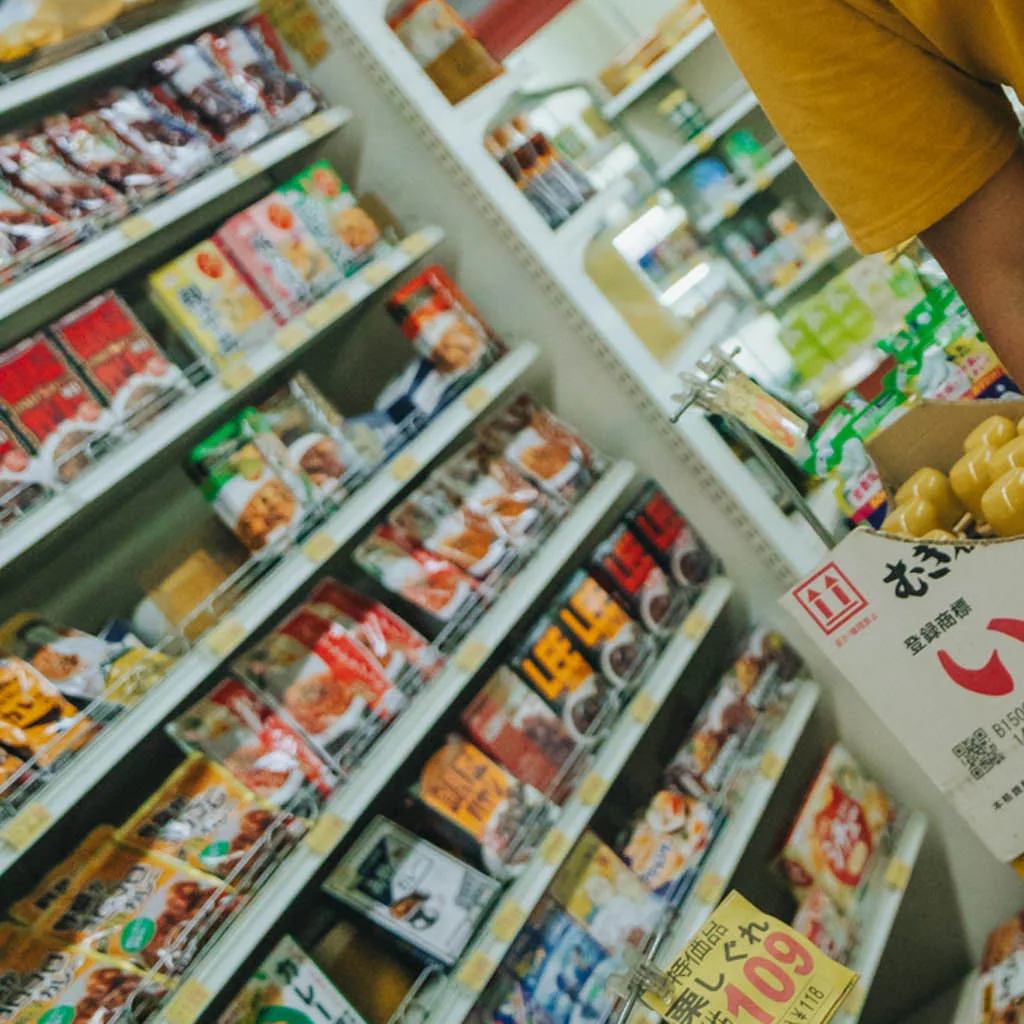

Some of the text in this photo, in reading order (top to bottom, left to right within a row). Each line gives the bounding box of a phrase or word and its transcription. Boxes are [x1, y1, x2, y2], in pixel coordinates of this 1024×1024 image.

[903, 596, 972, 656] 登録商標
[667, 920, 728, 985] 特価品
[723, 931, 814, 1024] 109
